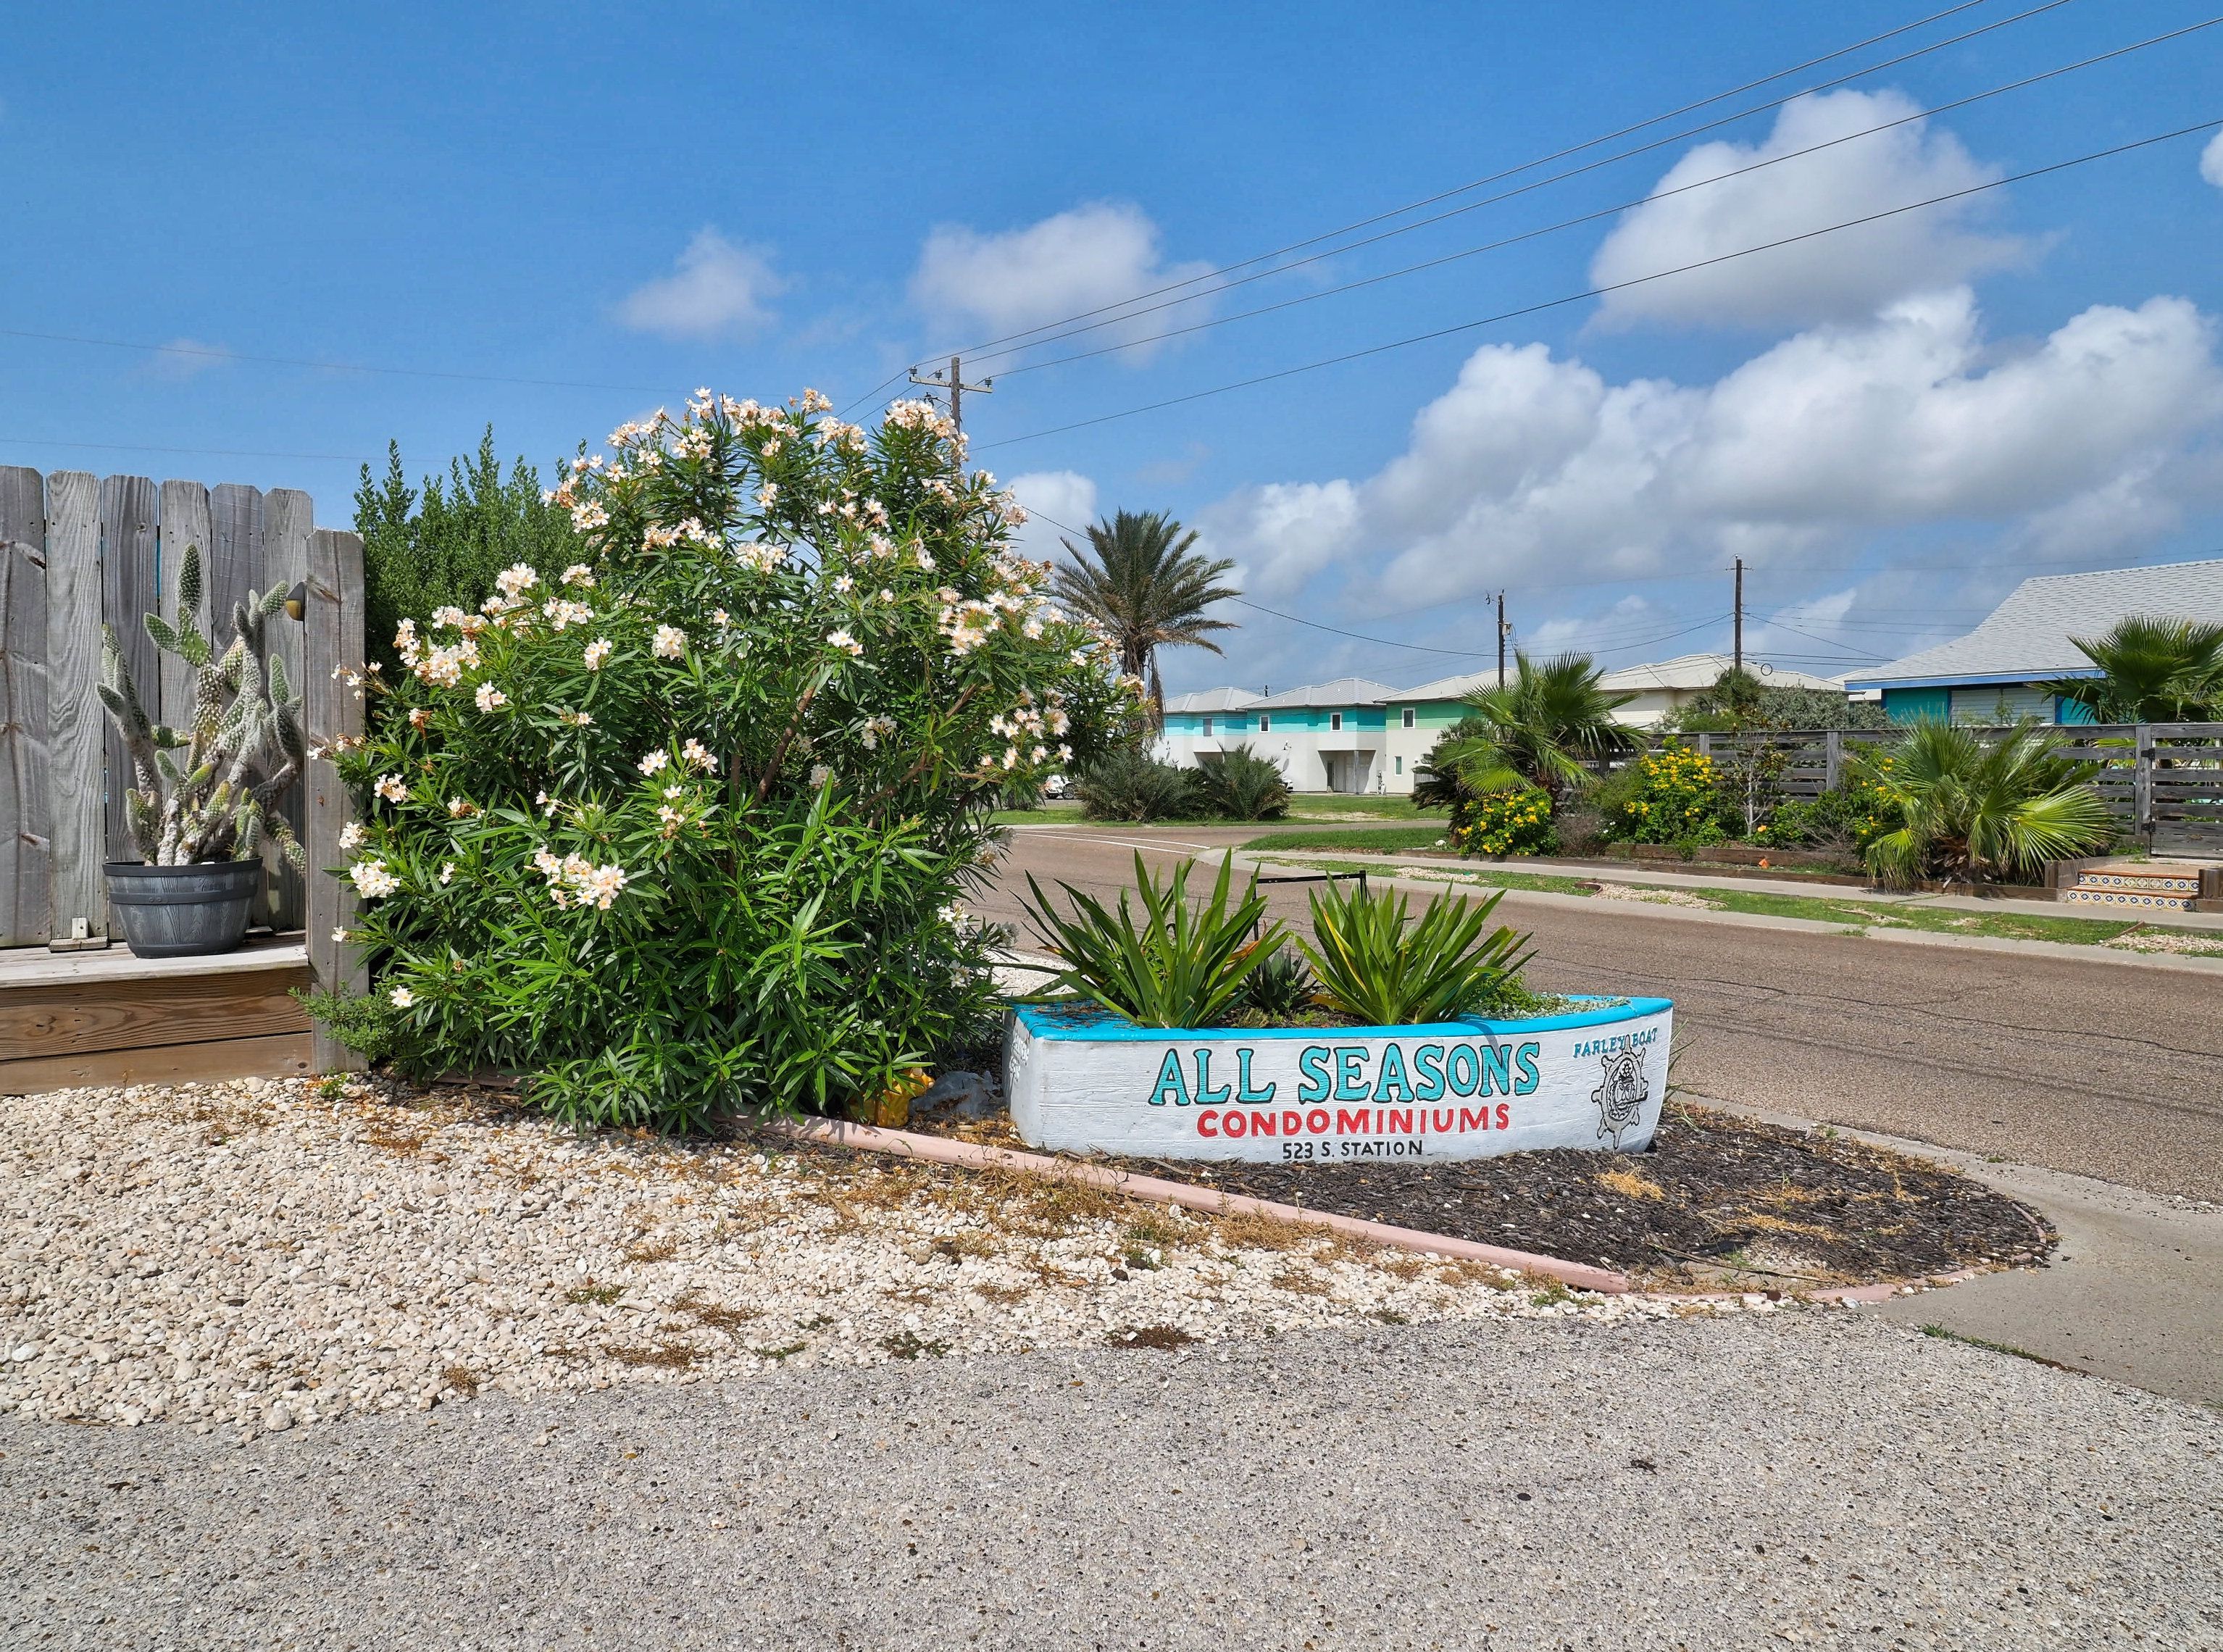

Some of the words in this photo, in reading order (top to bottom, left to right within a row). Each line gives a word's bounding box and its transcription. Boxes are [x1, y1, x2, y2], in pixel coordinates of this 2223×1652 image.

[1573, 1034, 1626, 1058] FARLEY
[1632, 1027, 1658, 1048] BOAT
[1148, 1048, 1277, 1106] ALL
[1298, 1042, 1540, 1105] SEASONS
[1196, 1103, 1509, 1138] CONDOMINIUMS
[1282, 1142, 1314, 1159] 523
[1322, 1141, 1335, 1158] S.
[1341, 1140, 1422, 1156] STATION
